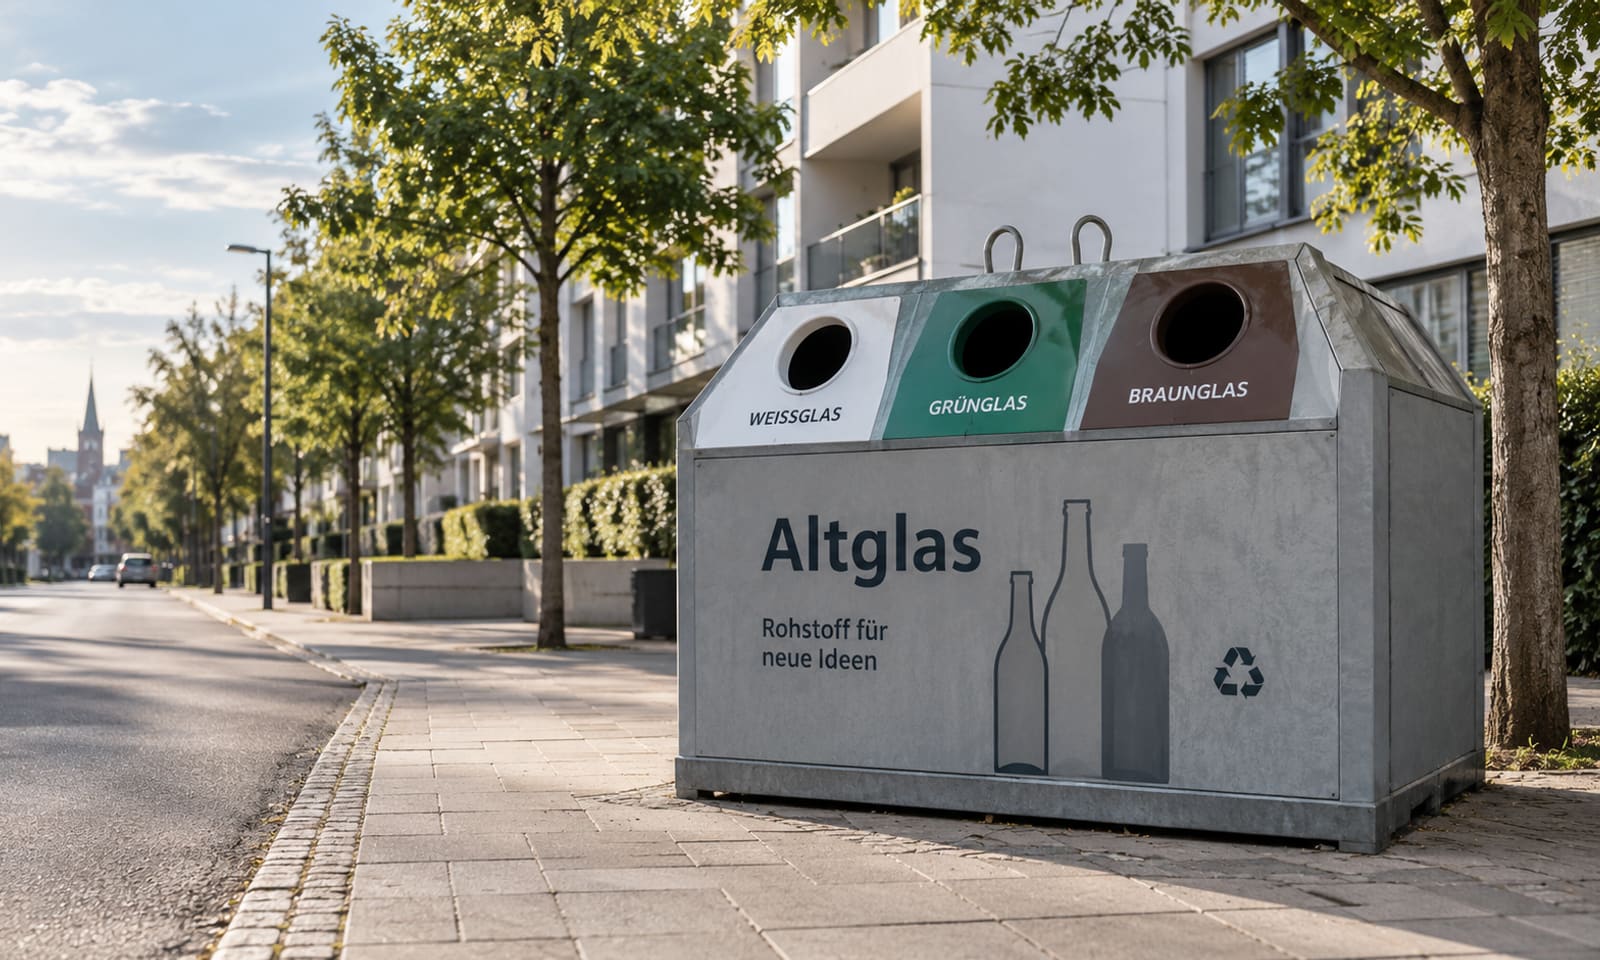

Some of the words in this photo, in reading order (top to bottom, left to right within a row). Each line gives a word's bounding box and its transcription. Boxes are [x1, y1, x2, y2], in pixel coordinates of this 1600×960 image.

[1128, 381, 1249, 404] BRAUNGLAS
[749, 406, 842, 427] WEISSGLAS
[929, 394, 1028, 416] GRÜNGLAS
[761, 513, 981, 588] Altglas
[763, 617, 851, 640] Rohstoff
[856, 617, 888, 641] für
[762, 651, 812, 669] neue
[818, 648, 877, 672] Ideen
